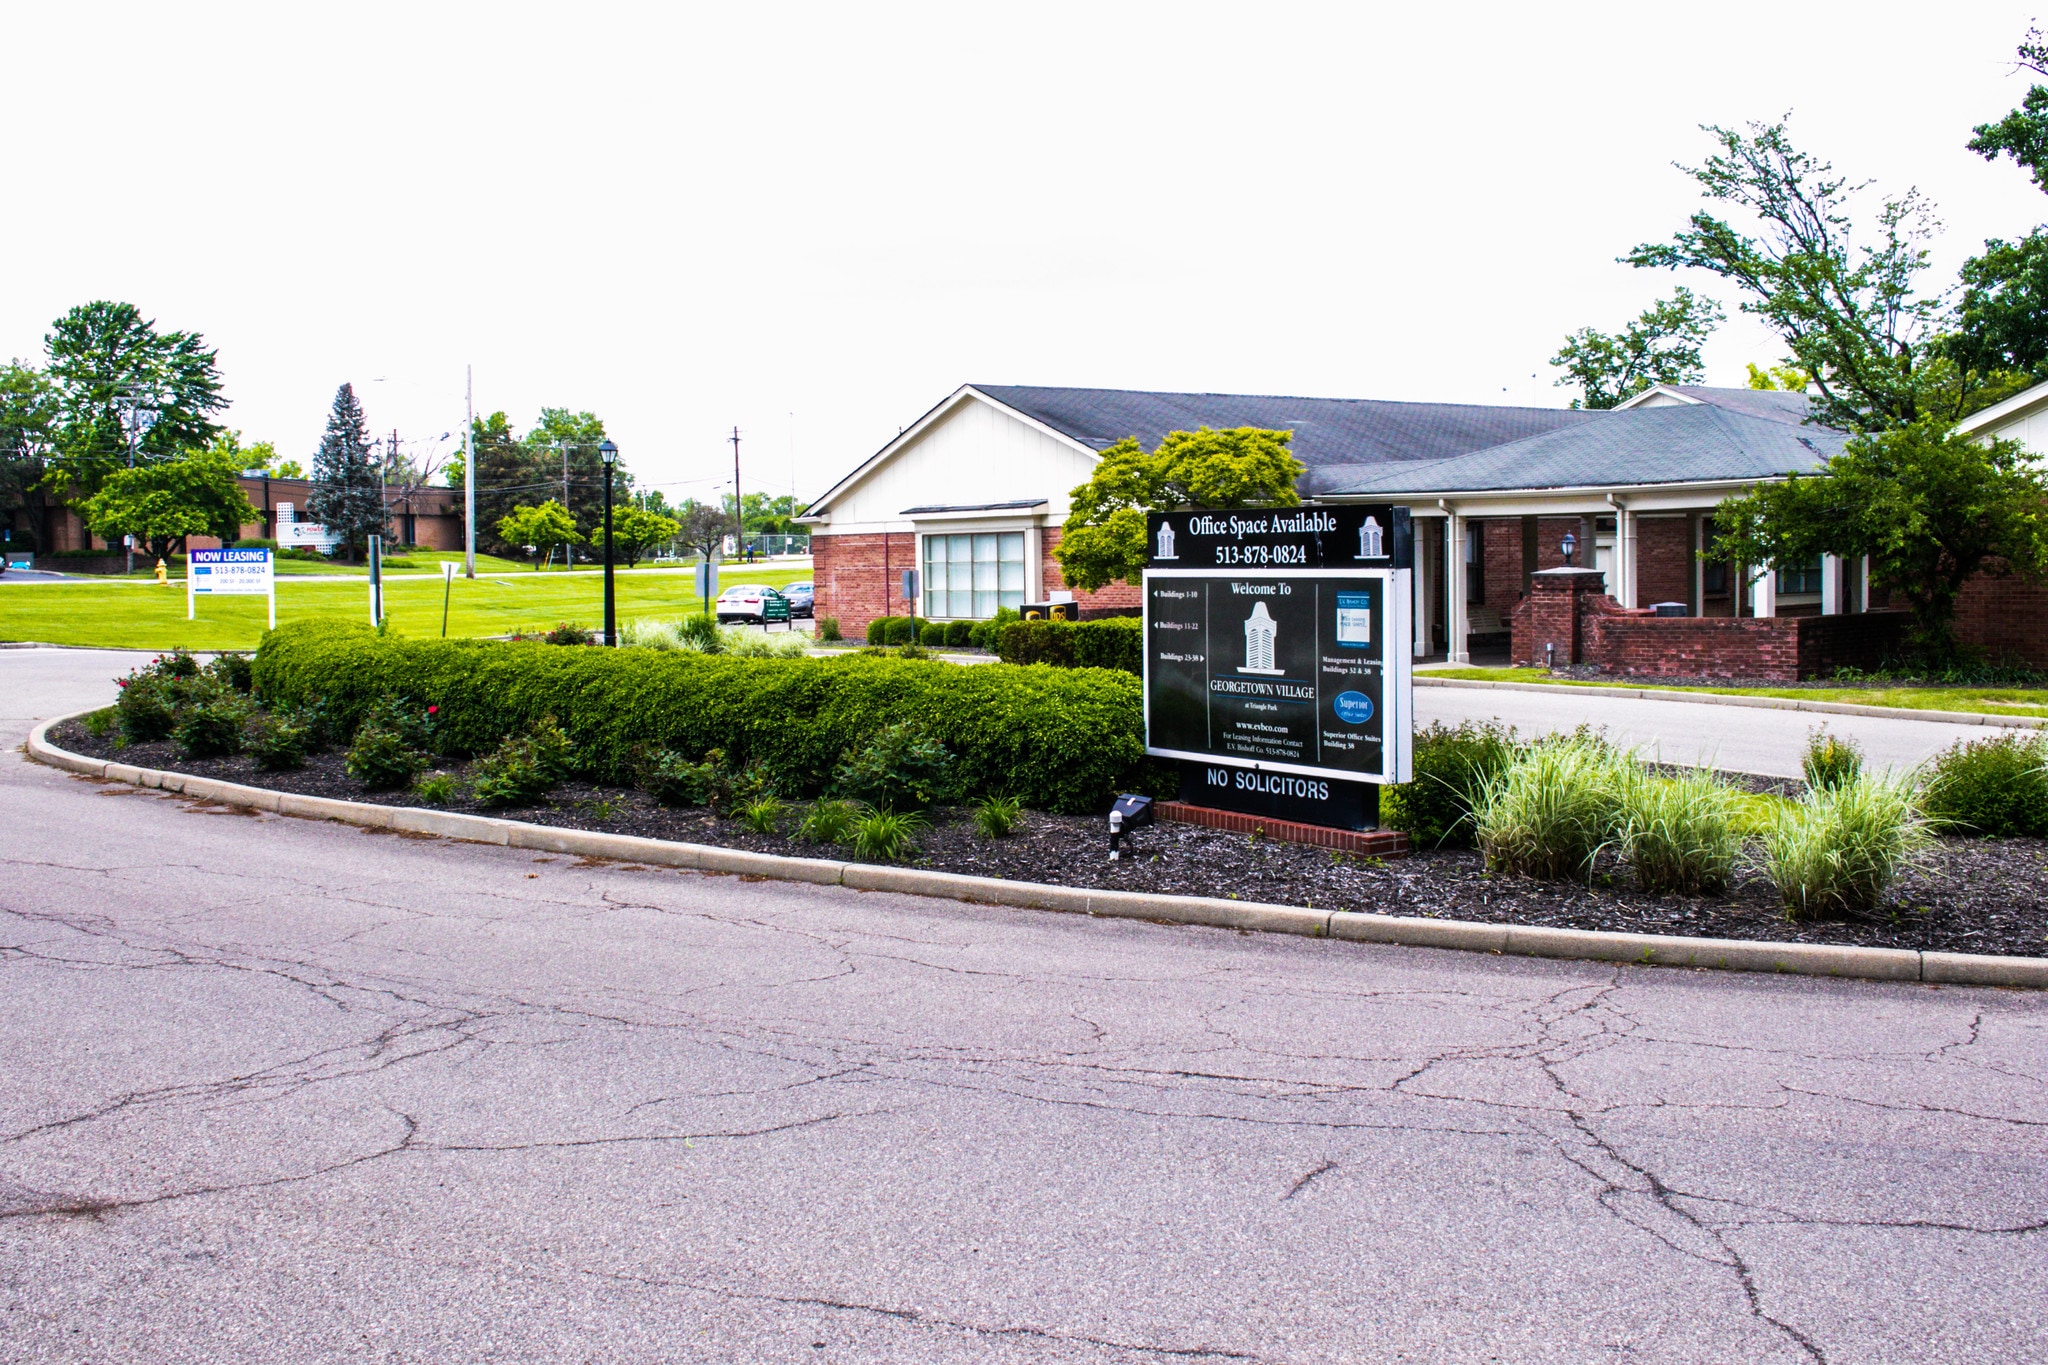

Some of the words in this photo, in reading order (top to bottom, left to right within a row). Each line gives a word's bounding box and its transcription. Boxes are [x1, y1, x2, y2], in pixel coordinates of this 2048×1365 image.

[1189, 516, 1227, 535] Office
[1229, 515, 1267, 539] Space
[1271, 511, 1337, 533] Available
[196, 551, 221, 562] NOW
[223, 551, 264, 562] LEASING
[1216, 545, 1306, 564] 513-878-0824
[215, 566, 266, 574] 513-878-0824
[1231, 582, 1276, 595] Welcome
[1278, 583, 1292, 595] To
[1160, 590, 1185, 600] Buildings
[1159, 621, 1183, 631] Buildings
[1160, 653, 1183, 662] Buildings
[1322, 656, 1356, 664] Management
[1322, 665, 1348, 674] Buildings
[1210, 679, 1273, 695] GEORGETOWN
[1275, 684, 1315, 699] VILLAGE
[1250, 702, 1267, 711] Triangle
[1267, 703, 1278, 711] Park
[1339, 697, 1368, 709] Superior
[1235, 721, 1289, 734] www.evbco.com
[1232, 733, 1251, 743] Leasing
[1252, 735, 1282, 744] Information
[1282, 739, 1303, 748] Contact
[1323, 730, 1346, 739] Superior
[1364, 734, 1381, 742] Suites
[1323, 740, 1346, 750] Building
[1207, 768, 1228, 788] NO
[1235, 771, 1329, 801] SOLICITORS
